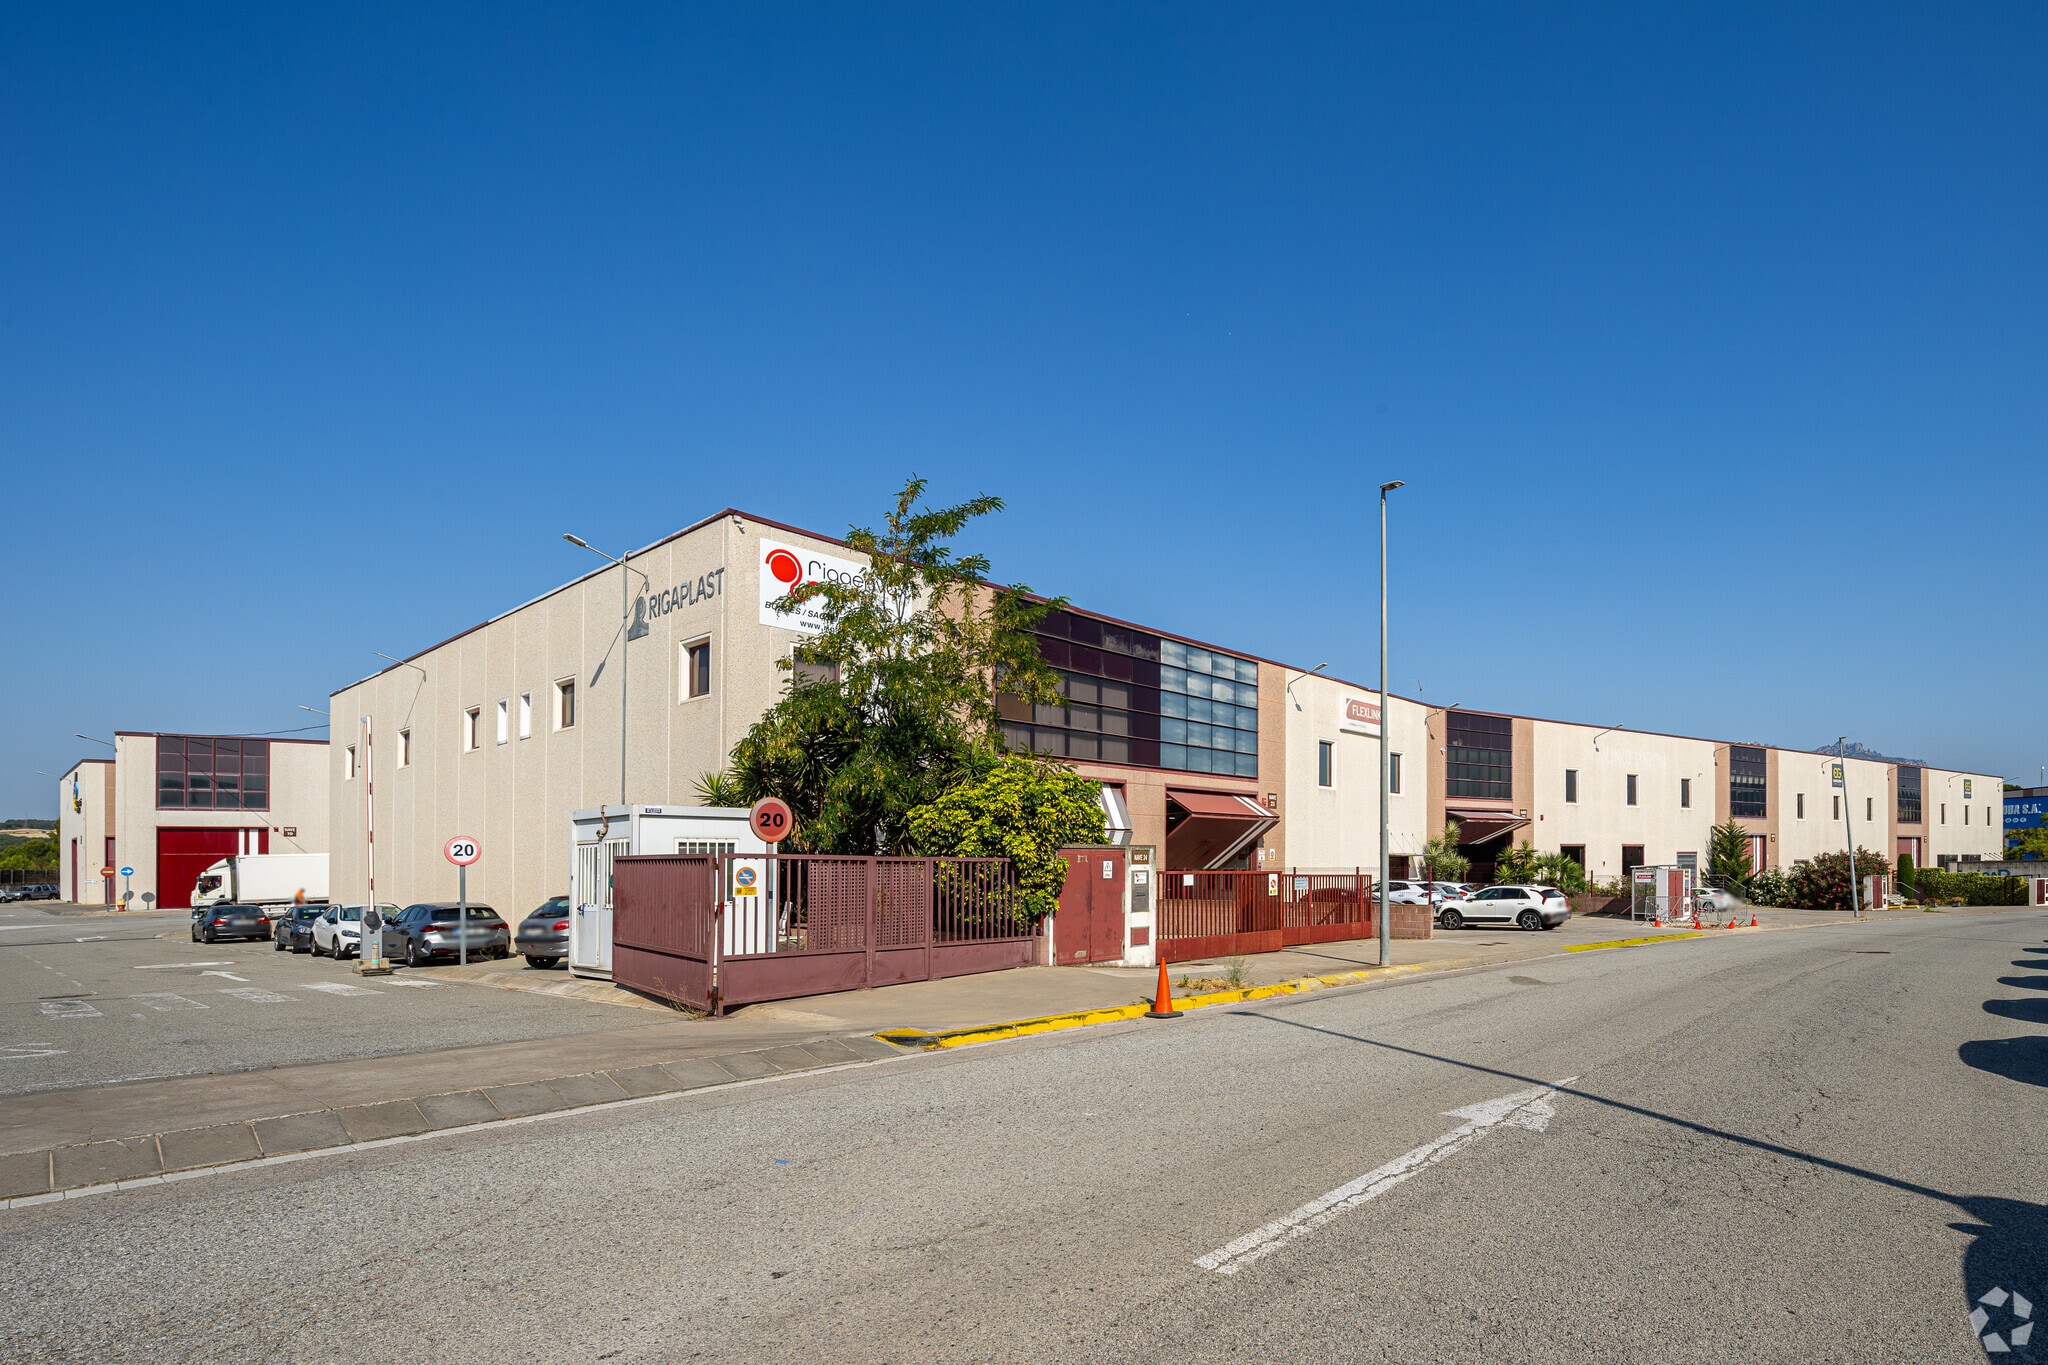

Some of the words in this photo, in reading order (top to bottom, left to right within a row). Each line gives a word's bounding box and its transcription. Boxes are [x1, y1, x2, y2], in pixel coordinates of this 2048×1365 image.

[649, 567, 724, 620] RIGAPLAST
[760, 812, 784, 828] 20
[453, 844, 474, 857] 20
